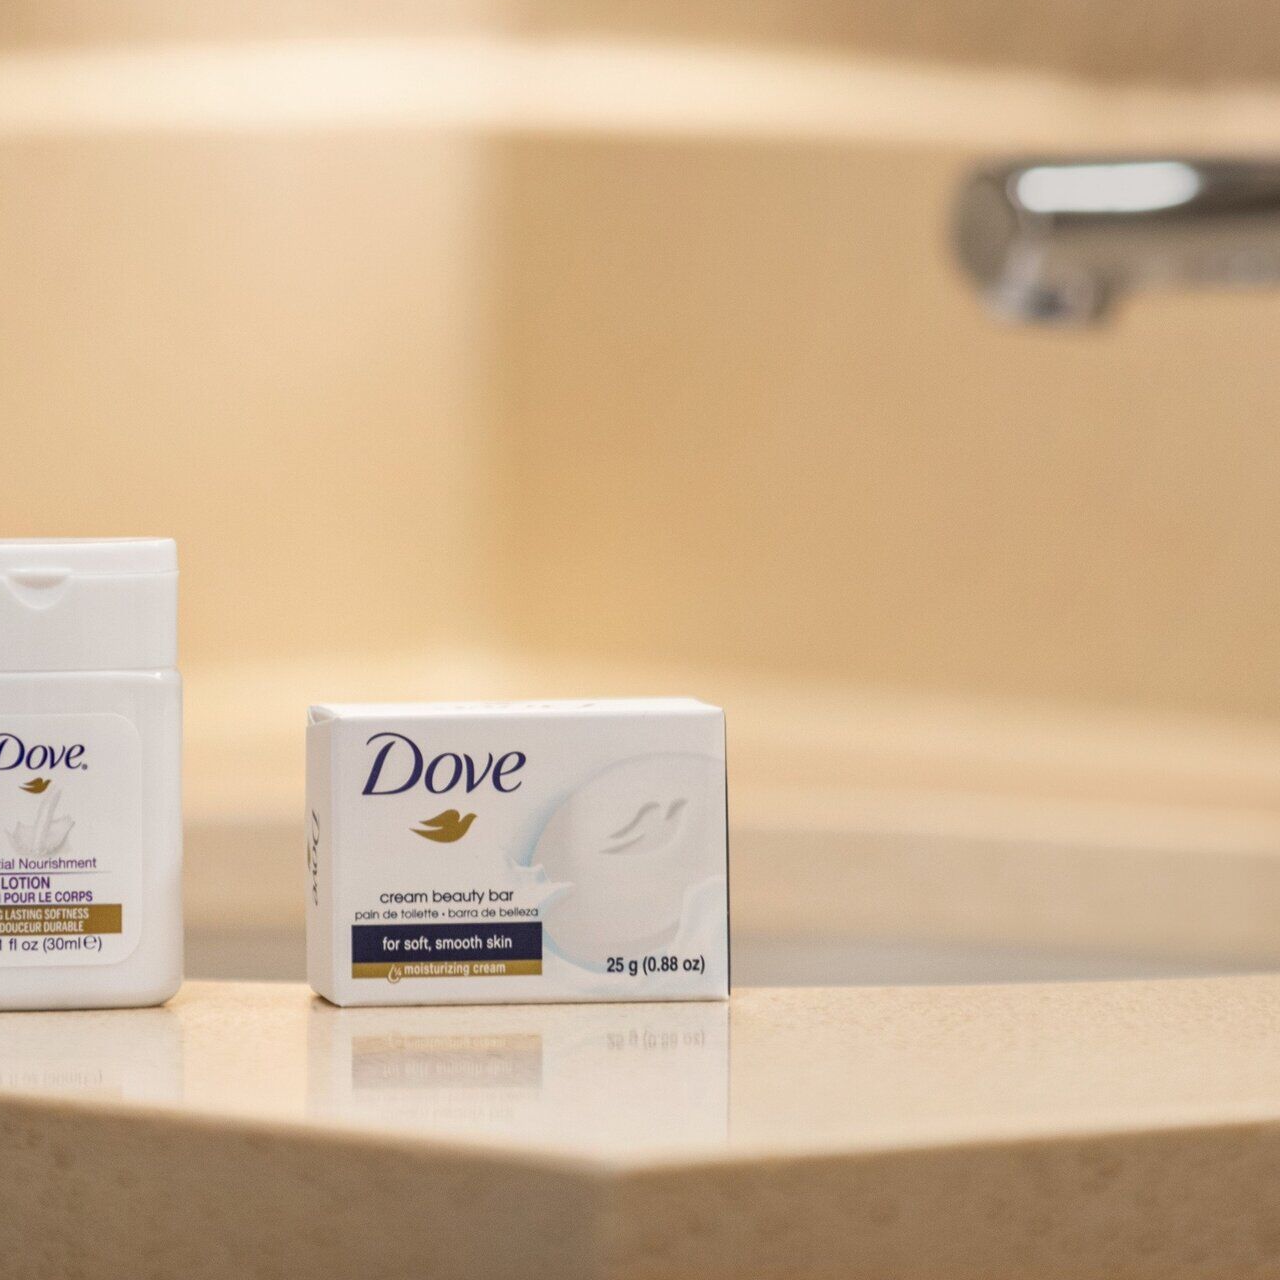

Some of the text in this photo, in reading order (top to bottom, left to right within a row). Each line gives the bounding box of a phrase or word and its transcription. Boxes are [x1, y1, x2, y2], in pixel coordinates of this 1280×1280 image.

[362, 732, 527, 796] Dove
[19, 857, 97, 869] Nourishment
[1, 876, 51, 890] LOTION
[4, 892, 36, 903] POUR
[39, 891, 52, 903] LE
[55, 891, 93, 902] CORPS
[380, 889, 514, 904] cream beauty bar
[5, 908, 43, 920] LASTING
[44, 908, 89, 919] SOFTNESS
[355, 906, 539, 921] pain de toilette barra de belleza
[0, 921, 42, 933] DOUCEUR
[43, 921, 84, 932] DURABLE
[9, 938, 17, 951] fl
[22, 940, 38, 951] oz
[383, 934, 512, 951] for soft, smooth skin
[404, 963, 469, 976] moisturizing
[473, 963, 506, 974] cream
[607, 955, 705, 976] 25 g (0.88 oz)
